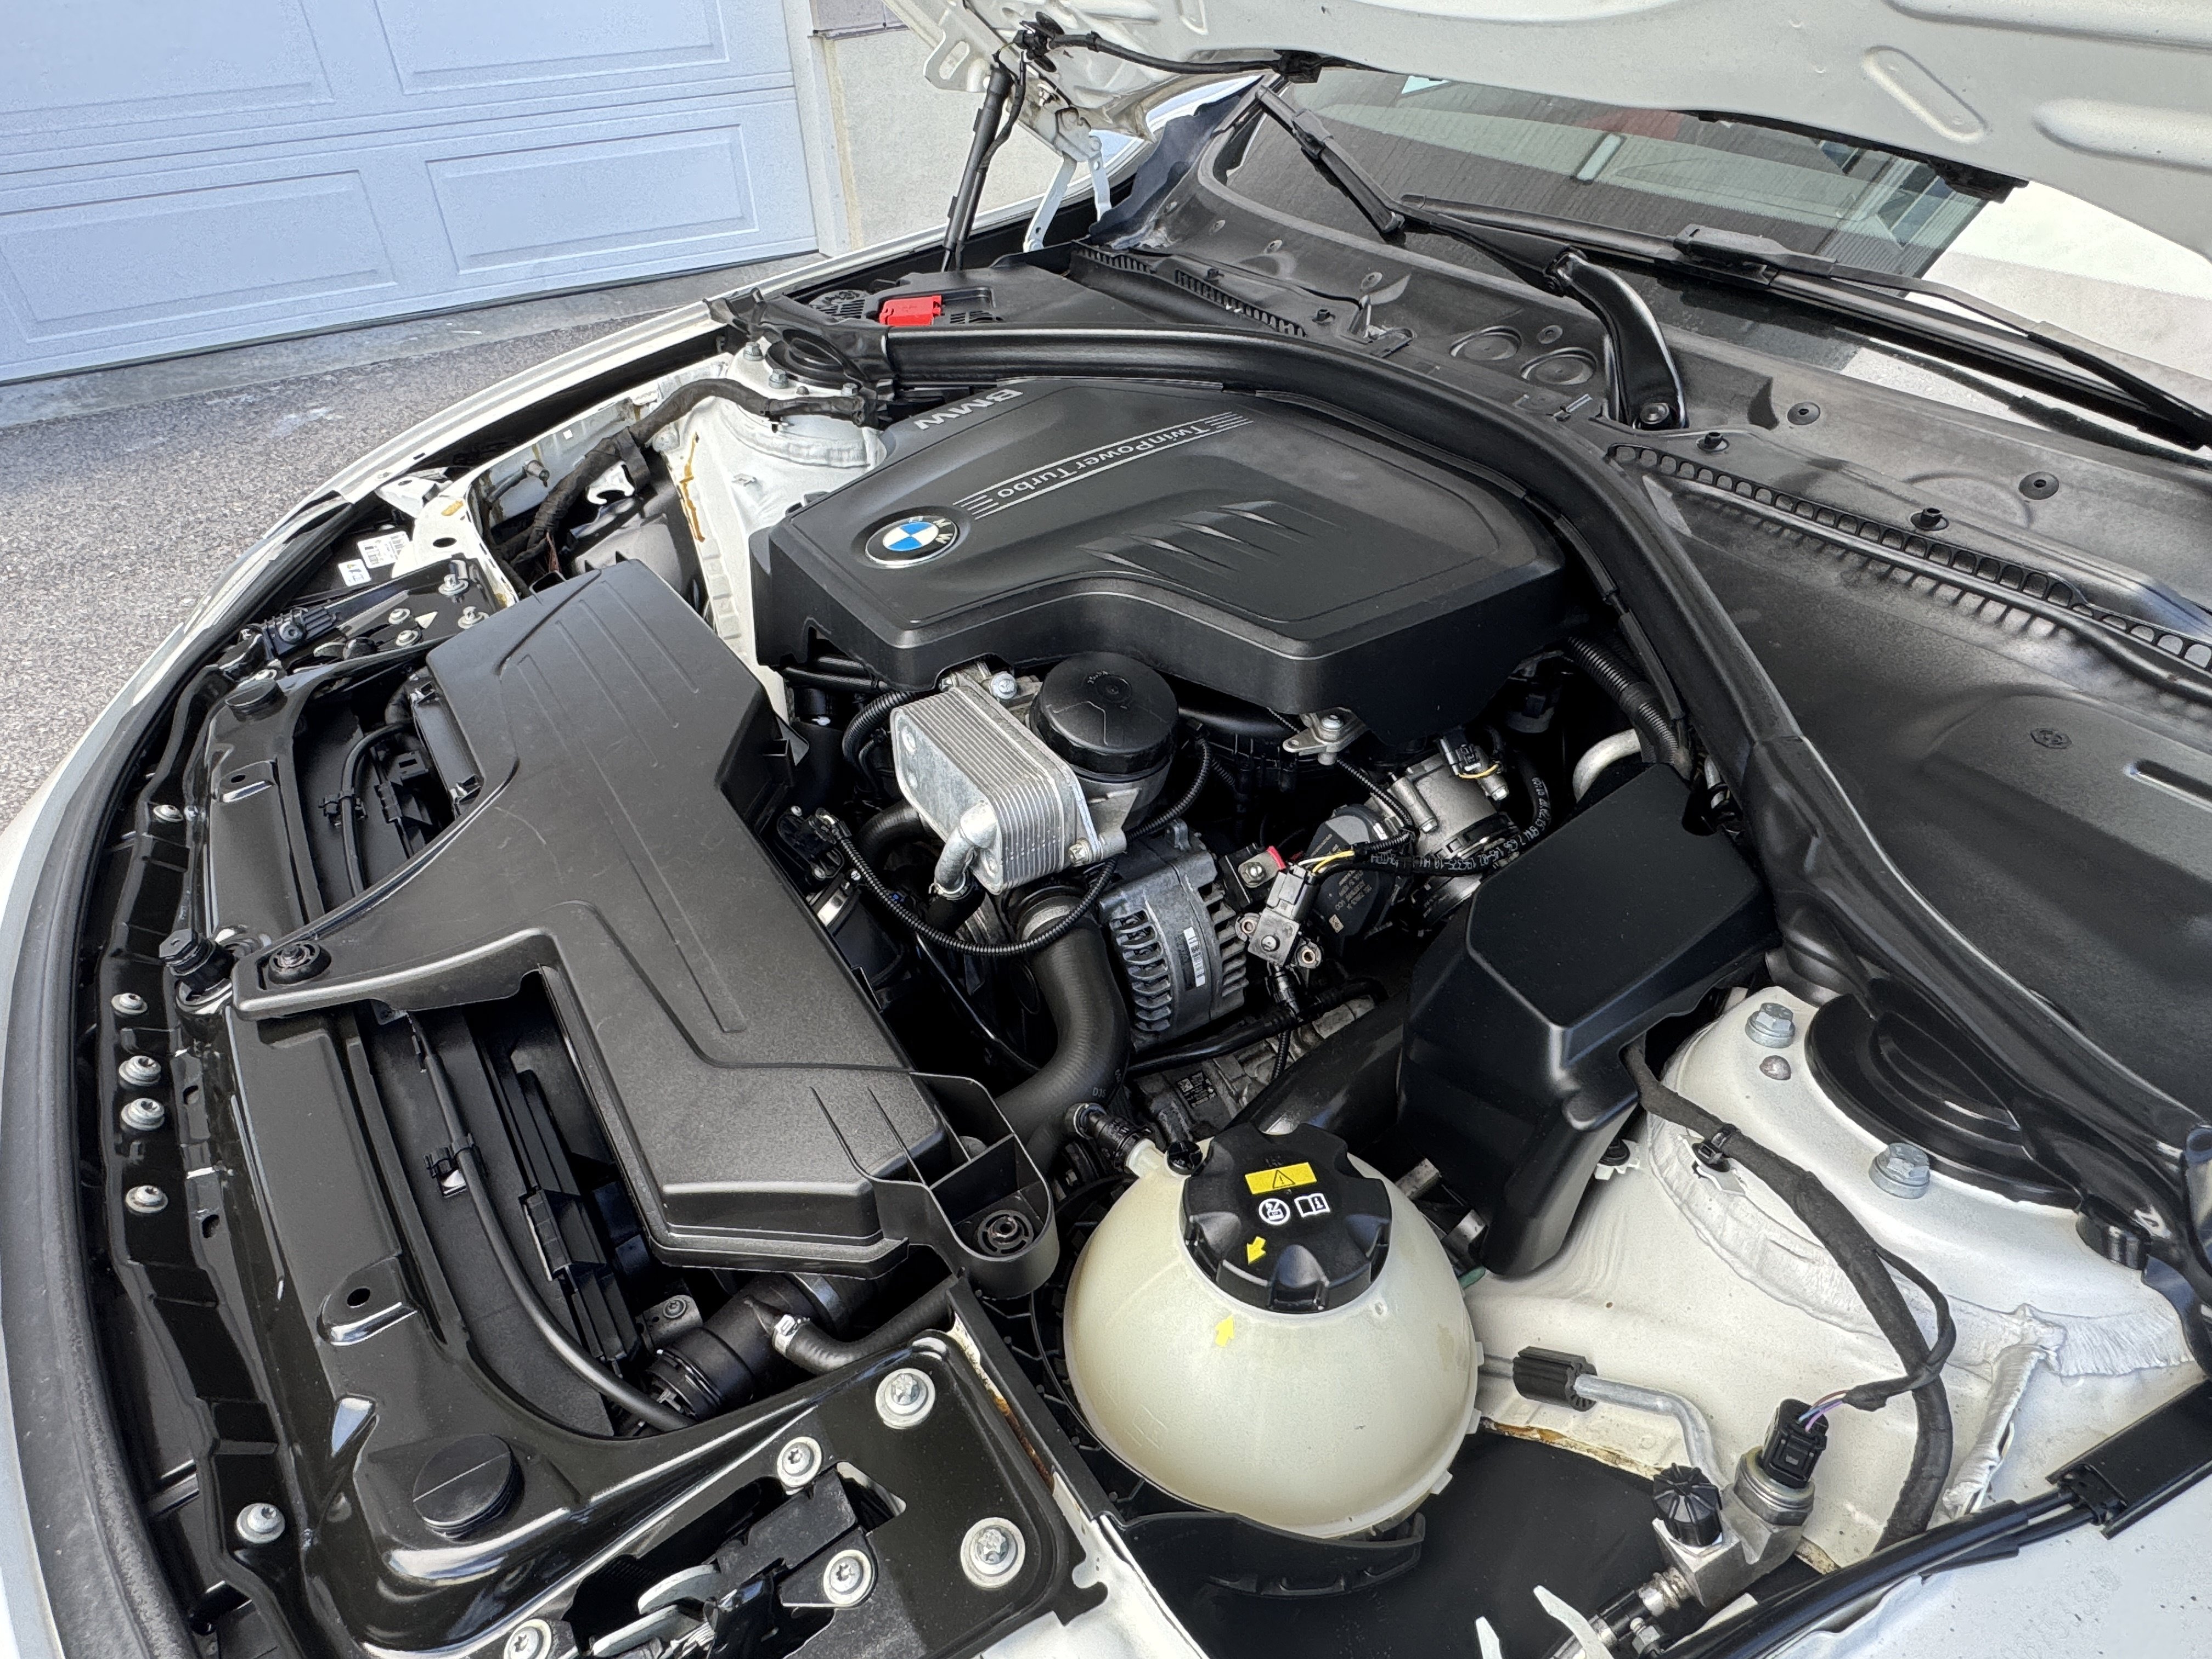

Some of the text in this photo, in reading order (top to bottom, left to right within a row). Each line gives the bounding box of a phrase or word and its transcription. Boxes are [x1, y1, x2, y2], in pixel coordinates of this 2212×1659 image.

[913, 389, 1024, 430] BMW
[997, 425, 1210, 498] TwinPower Turbo
